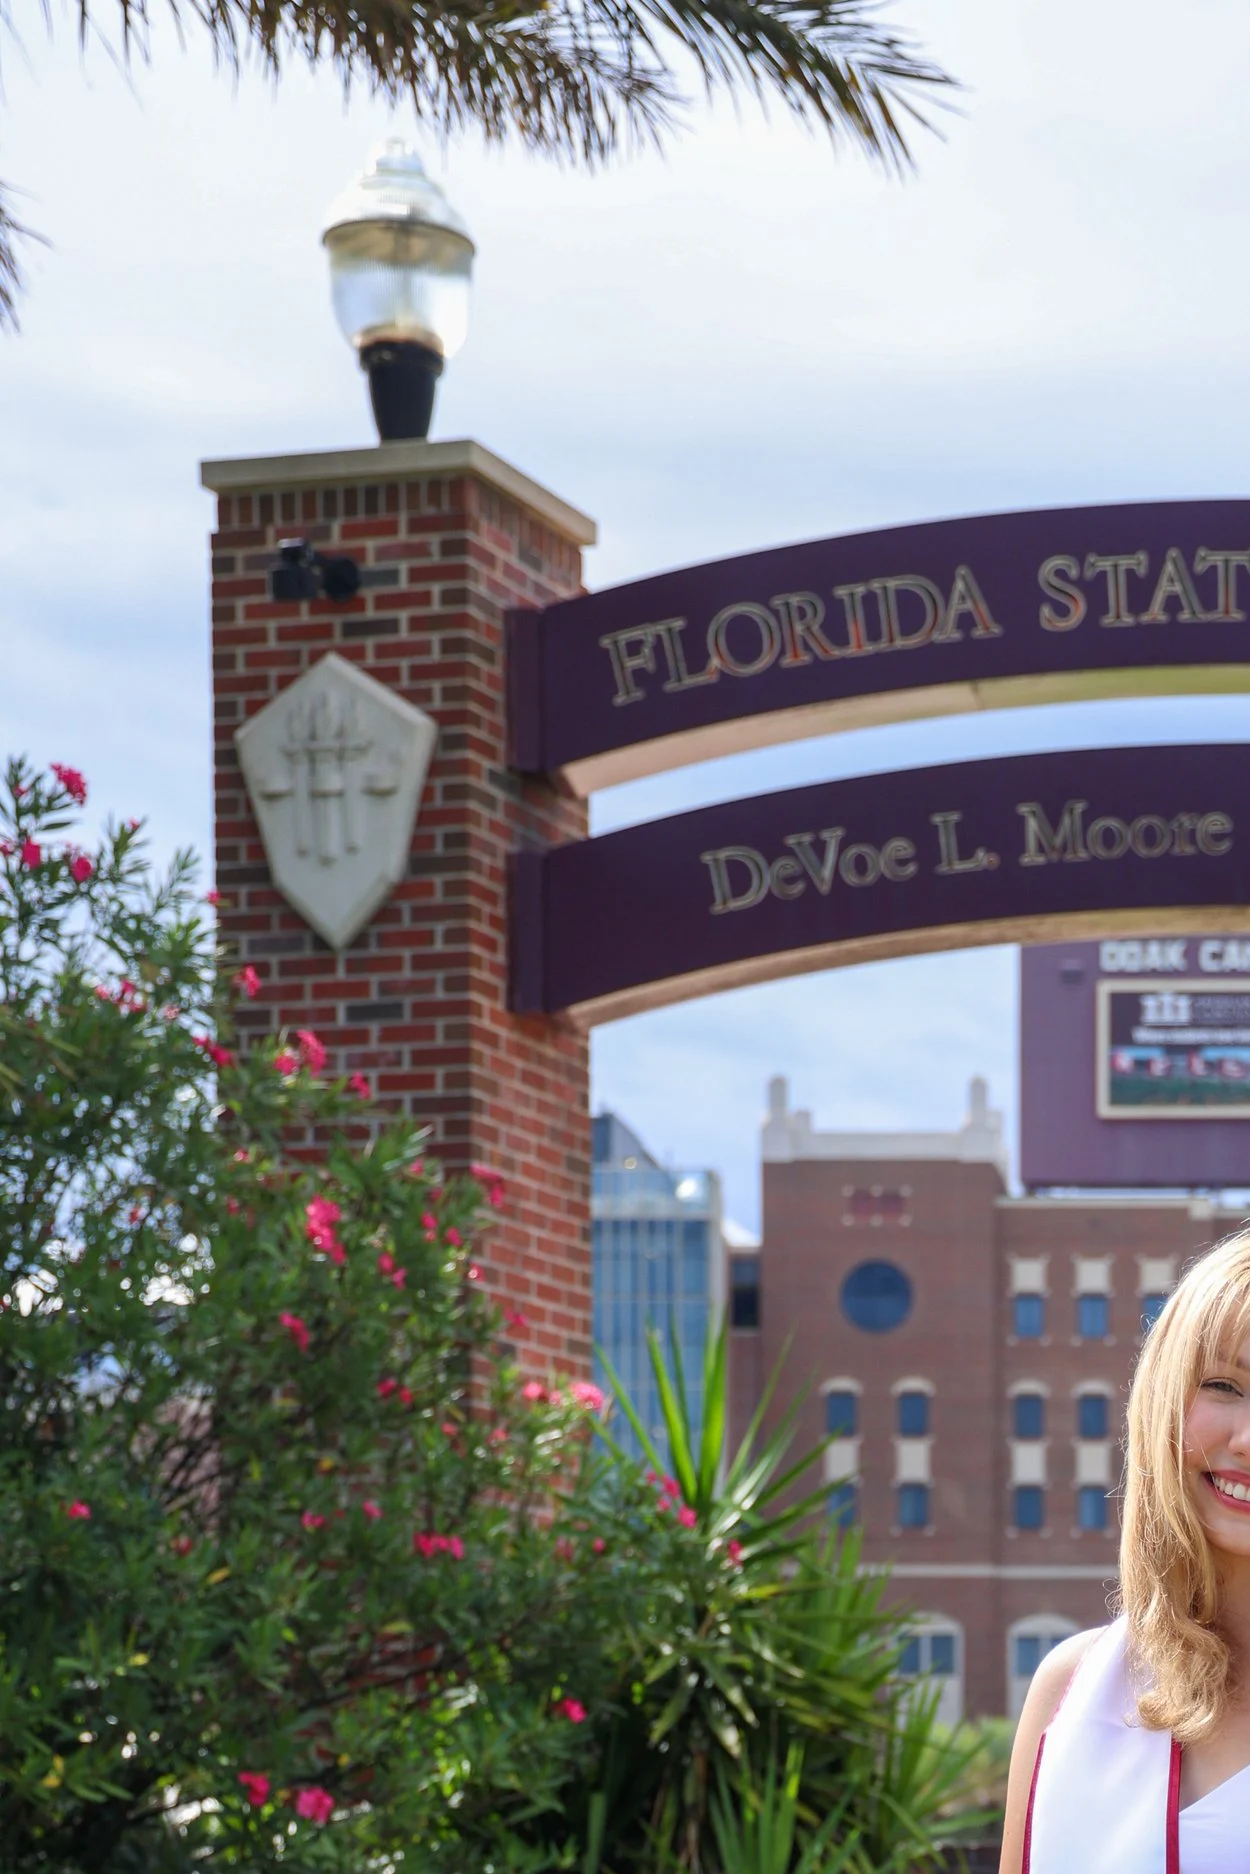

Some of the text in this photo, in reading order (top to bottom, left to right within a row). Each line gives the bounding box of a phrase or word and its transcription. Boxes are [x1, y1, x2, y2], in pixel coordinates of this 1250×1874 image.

[600, 565, 1002, 705] FLORIDA
[701, 827, 916, 915] DeVoe
[931, 811, 998, 874] L.
[1018, 800, 1234, 866] Moore
